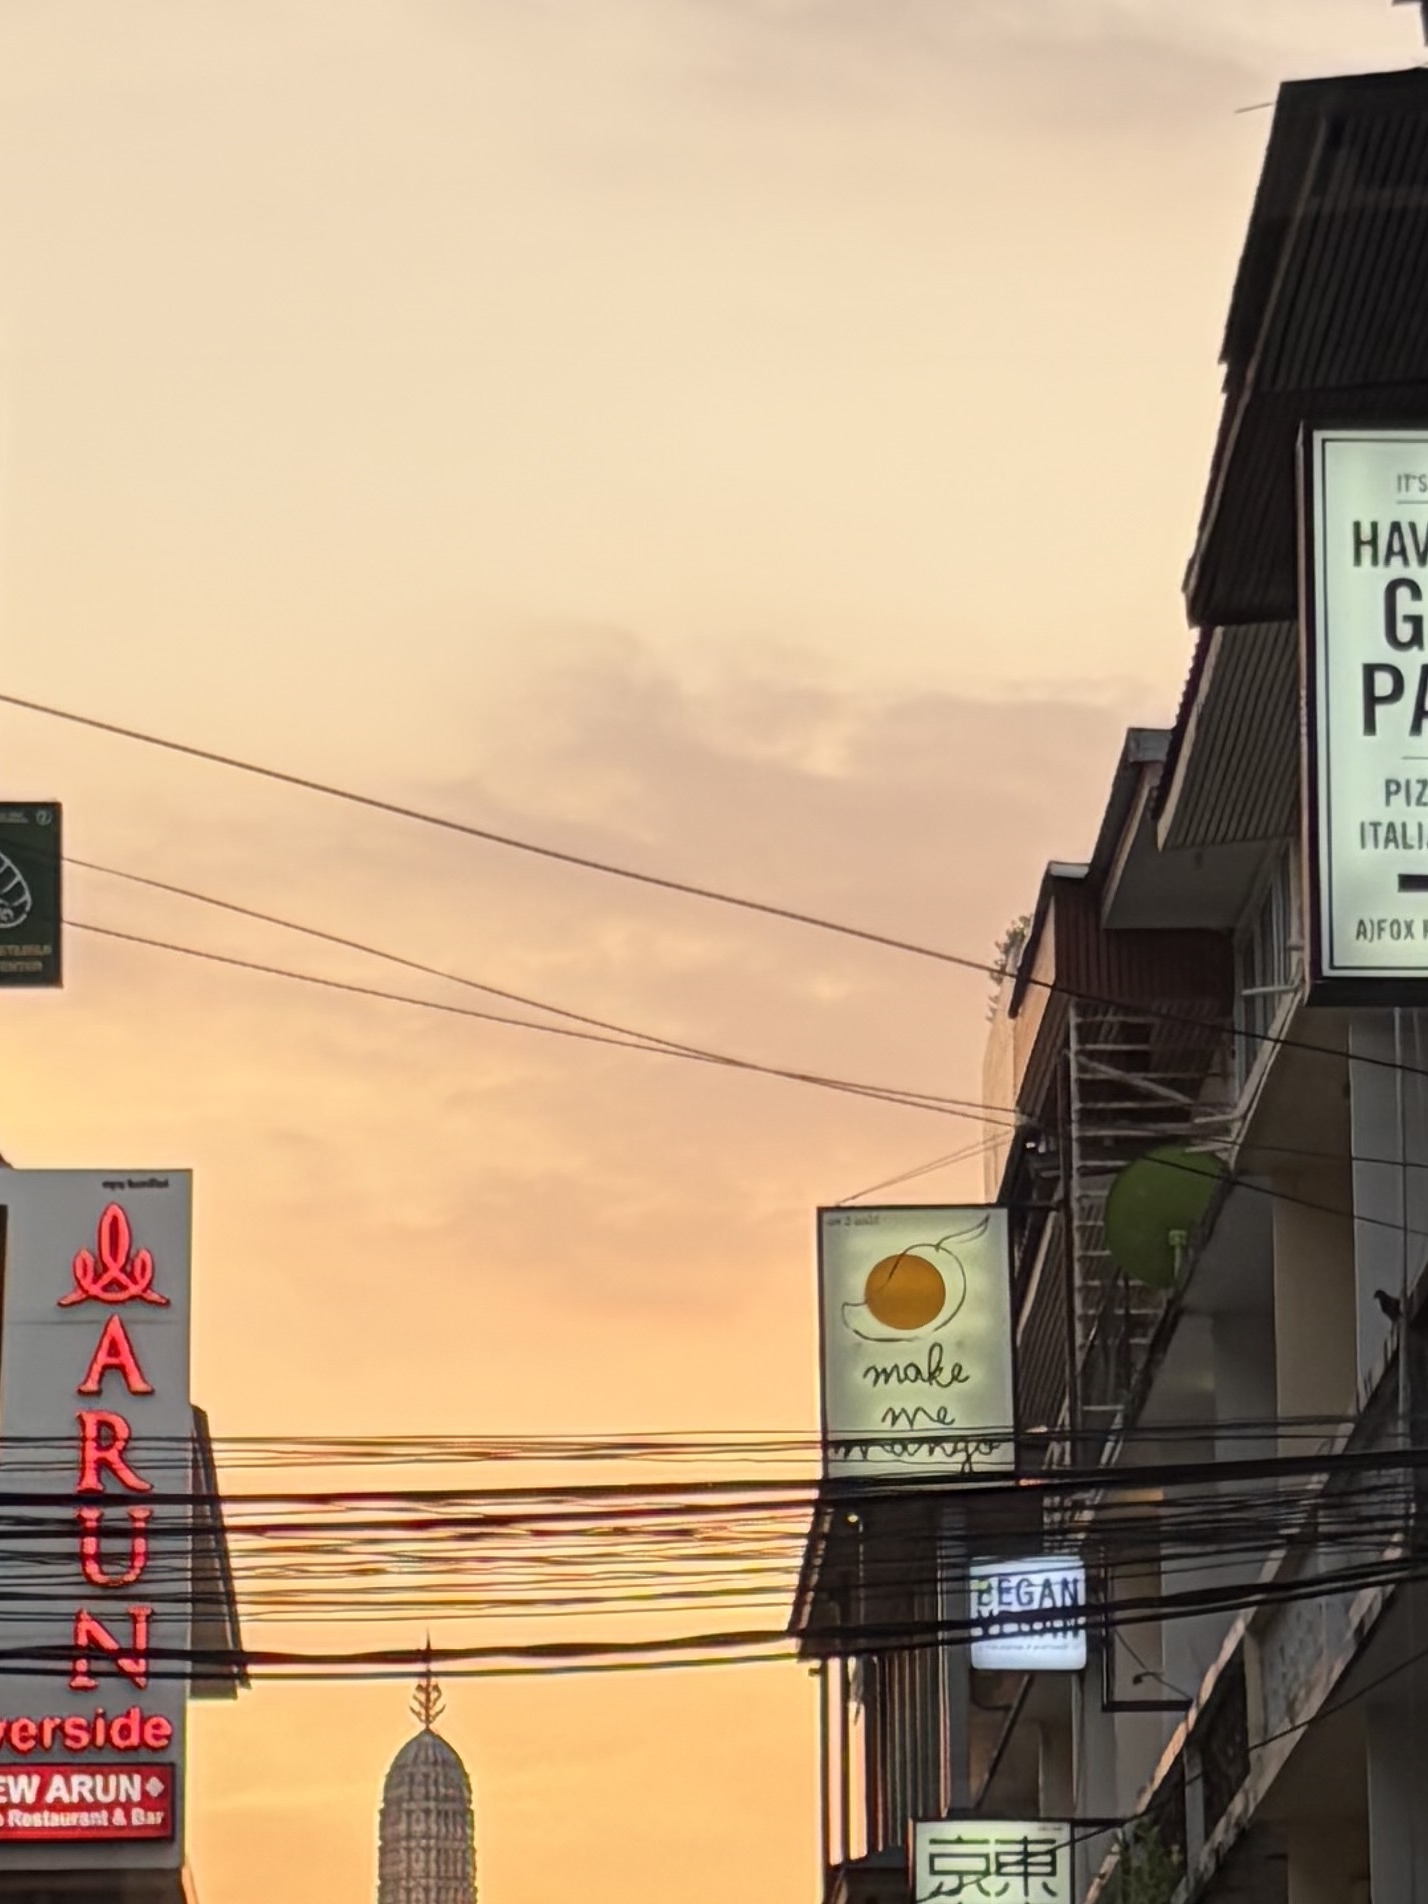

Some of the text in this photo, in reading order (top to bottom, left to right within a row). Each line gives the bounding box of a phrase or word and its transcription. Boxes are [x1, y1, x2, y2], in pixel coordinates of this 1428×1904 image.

[1396, 473, 1428, 494] IT'S
[1355, 918, 1415, 943] A)FOX
[863, 1342, 970, 1389] make
[881, 1405, 956, 1431] me
[68, 1312, 156, 1693] ARUN
[45, 1772, 142, 1804] ARUN
[8, 1808, 109, 1828] Restaurant
[131, 1806, 165, 1825] Bar
